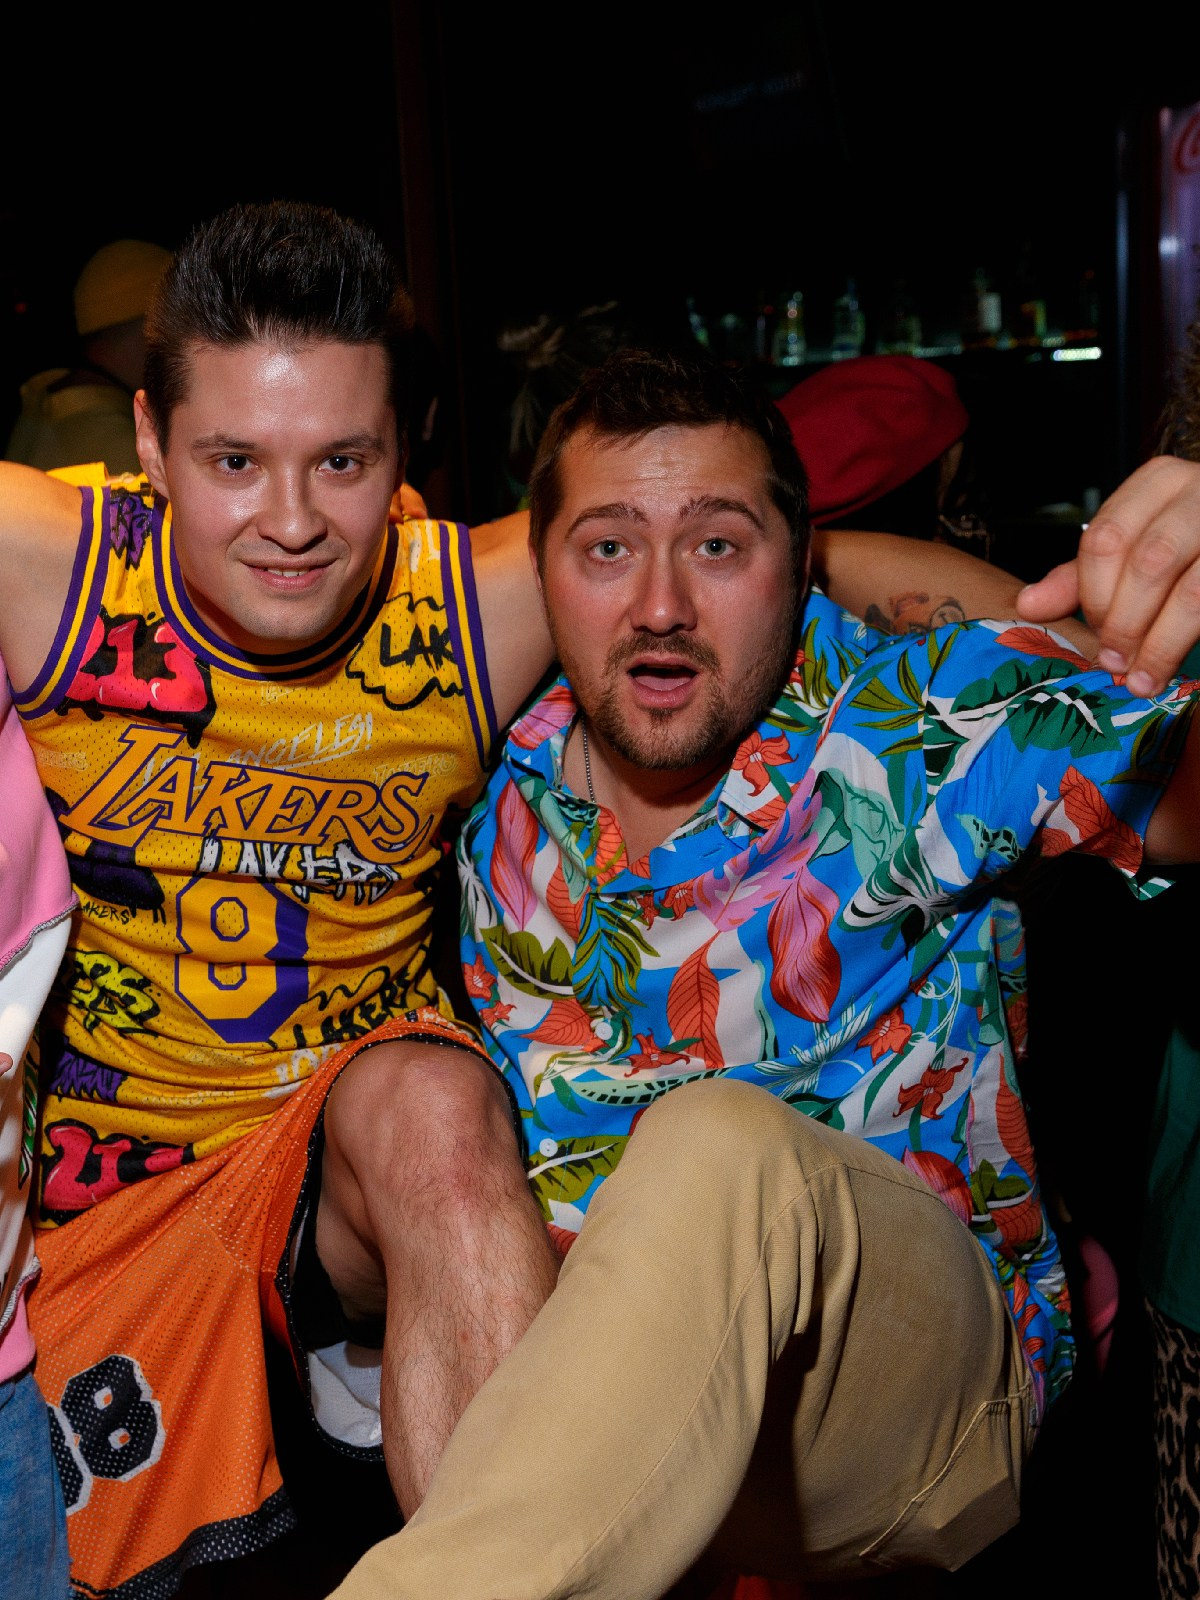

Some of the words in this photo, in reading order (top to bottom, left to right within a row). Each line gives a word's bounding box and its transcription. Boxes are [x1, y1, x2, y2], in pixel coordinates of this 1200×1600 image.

[60, 723, 435, 866] LAKERS
[77, 901, 131, 925] AKERS
[175, 873, 310, 1043] 8
